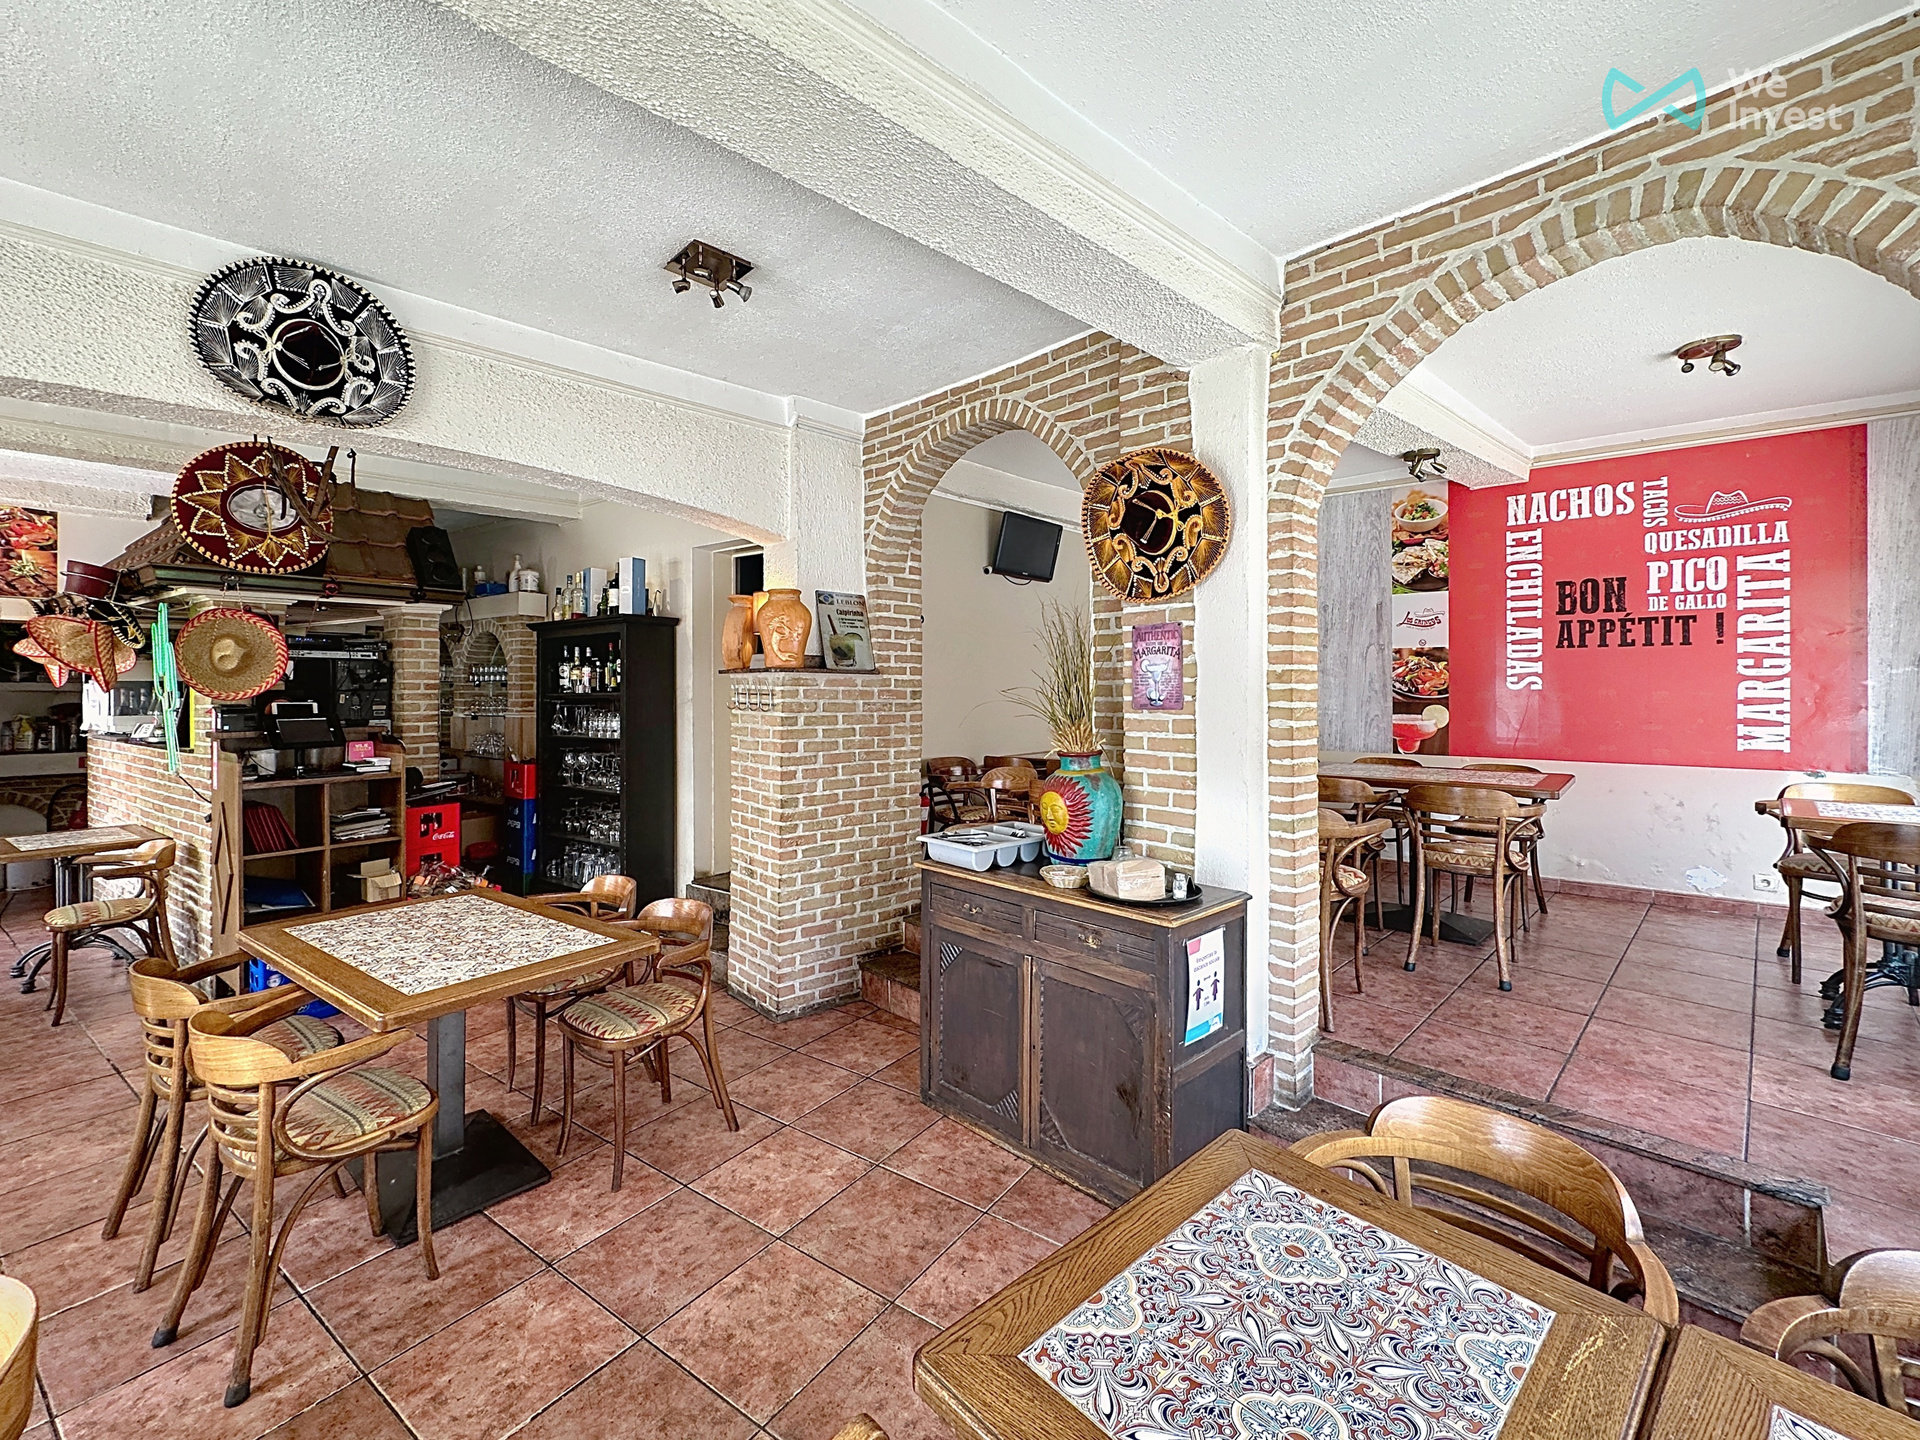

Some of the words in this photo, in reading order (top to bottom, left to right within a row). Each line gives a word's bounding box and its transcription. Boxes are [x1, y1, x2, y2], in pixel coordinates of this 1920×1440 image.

[1506, 481, 1636, 527] NACHOS
[1643, 476, 1668, 528] TACOS
[1644, 520, 1790, 555] QUESADILLA
[1646, 556, 1728, 595] PICO
[1505, 528, 1543, 691] ENCHILADAS
[1555, 576, 1627, 615] BON
[1647, 595, 1669, 611] DE
[1674, 592, 1728, 611] GALLO
[1135, 630, 1179, 643] AUTHENTIC
[1555, 612, 1697, 649] APPÉTIT
[1716, 612, 1725, 645] !
[1133, 646, 1181, 661] MARGARITA
[1736, 549, 1791, 753] MARGARITA
